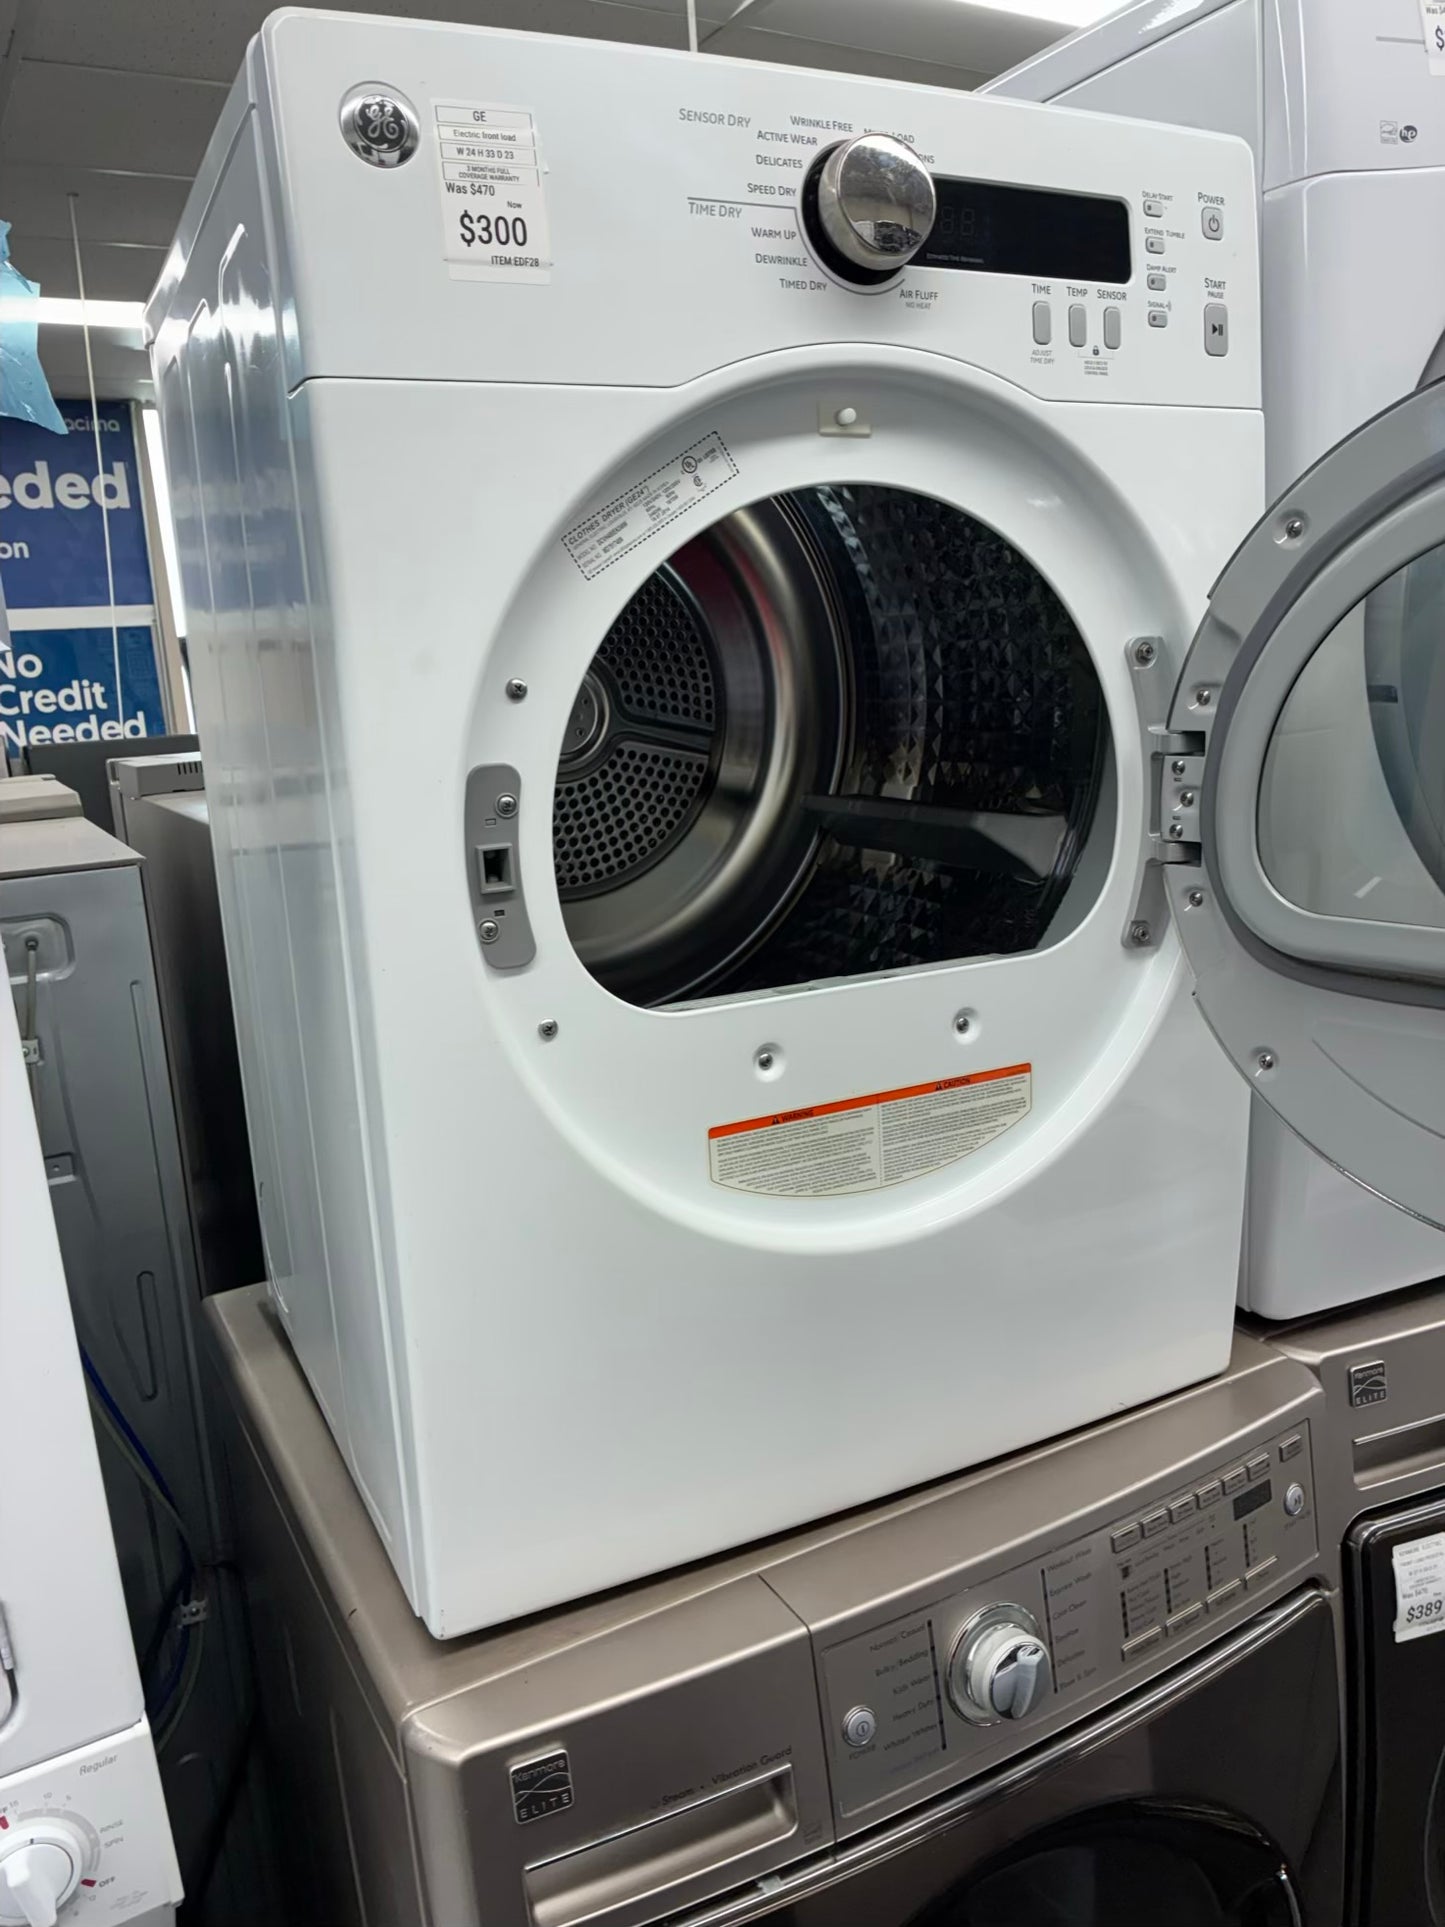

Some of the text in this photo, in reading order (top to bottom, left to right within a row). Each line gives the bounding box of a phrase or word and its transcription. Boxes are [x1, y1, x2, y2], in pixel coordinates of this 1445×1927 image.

[472, 110, 487, 122] GE
[679, 108, 751, 128] SENSOR DRY
[790, 115, 831, 130] WRINKLE
[832, 120, 854, 133] FREE
[453, 129, 516, 142] Electric front load
[757, 130, 818, 146] ACTIVE WEAR
[456, 147, 464, 156] W
[466, 148, 476, 156] 24
[478, 149, 484, 157] H
[485, 150, 495, 158] 33
[504, 151, 514, 160] 23
[756, 154, 803, 168] DELICATES
[458, 172, 520, 182] COVERAGE WARRANTY
[445, 182, 496, 196] Was $470
[747, 183, 797, 197] SPEED DRY
[507, 200, 522, 208] Now
[1198, 192, 1225, 206] POWER
[688, 201, 742, 218] TIME DRY
[460, 210, 528, 247] $300
[751, 227, 797, 240] WARM UP
[756, 253, 808, 267] DEWRINKLE
[779, 278, 828, 292] TIMED DRY
[1032, 284, 1052, 294] TIME
[1066, 286, 1088, 296] TEMP
[1204, 278, 1226, 290] START
[899, 289, 938, 302] AIR FLUFF
[1097, 289, 1127, 301] SENSOR
[1208, 290, 1224, 299] PAUSE
[568, 519, 600, 545] CLOTHES
[601, 502, 626, 522] DRYER
[0, 679, 108, 716] Credit
[0, 711, 147, 747] Needed
[943, 1078, 970, 1088] CAUTION
[781, 1110, 814, 1122] WARNING
[1356, 1390, 1384, 1404] ELITE
[1406, 1600, 1442, 1623] $389
[80, 1754, 118, 1776] Regular
[512, 1760, 566, 1784] Kenmore
[662, 1745, 792, 1806] Steam Vibration Guard
[520, 1792, 570, 1819] ELITE
[98, 1876, 116, 1888] OFF
